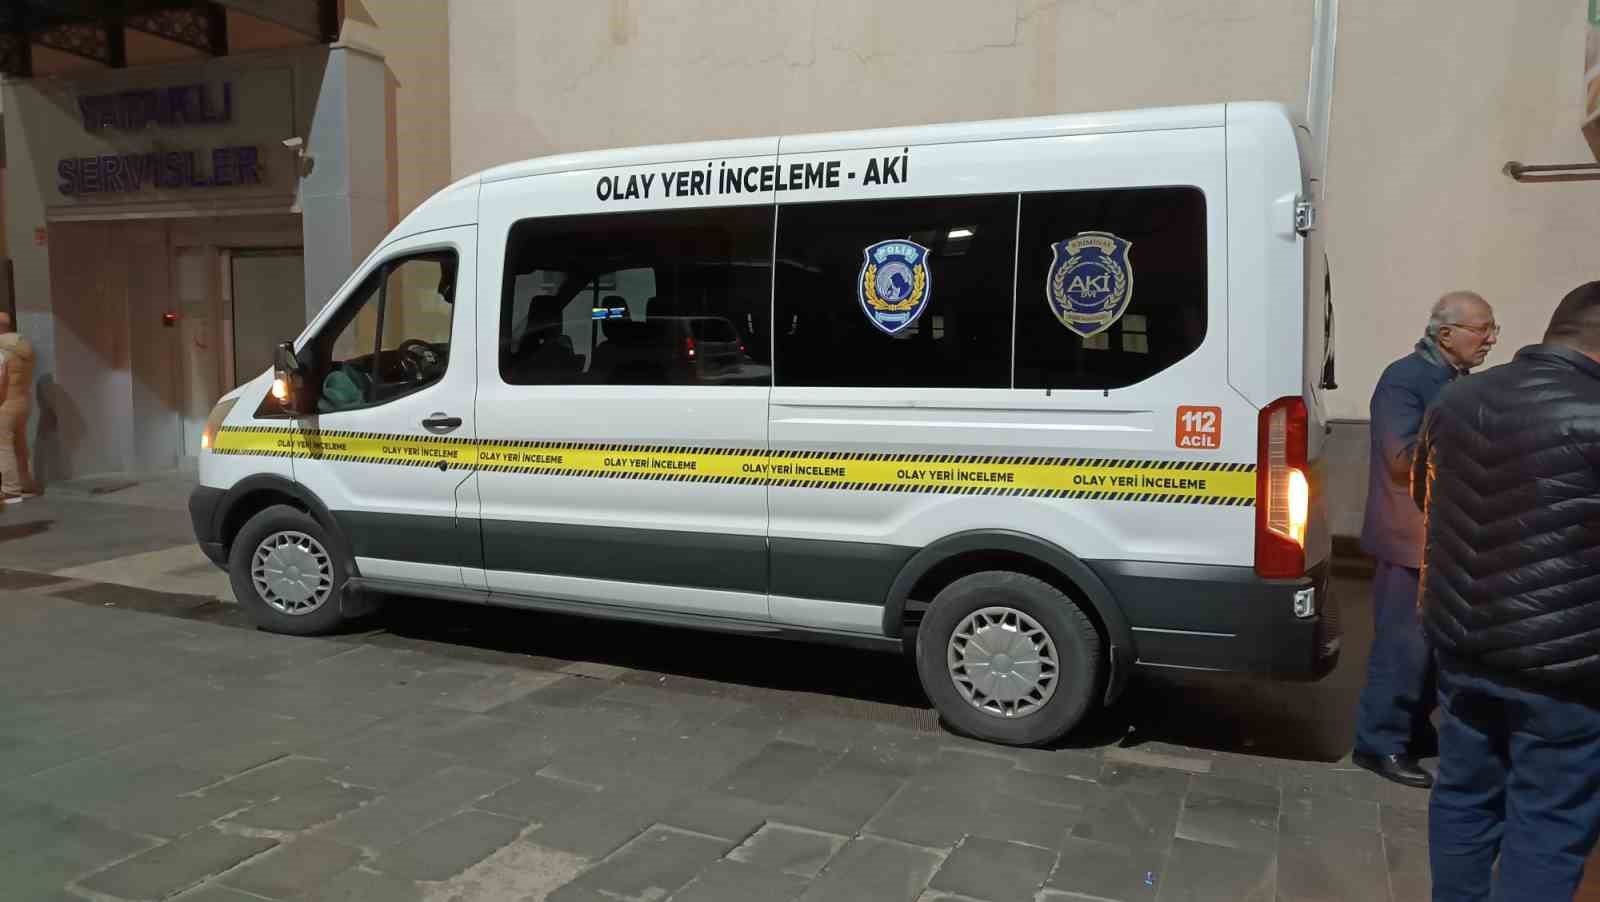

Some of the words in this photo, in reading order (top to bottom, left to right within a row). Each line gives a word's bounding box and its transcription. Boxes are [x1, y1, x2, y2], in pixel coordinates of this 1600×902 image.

[596, 173, 655, 201] OLAY
[661, 162, 712, 197] YERİ
[718, 161, 841, 194] İNCELEME
[862, 147, 909, 186] AKİ
[1067, 273, 1111, 292] AKİ
[1181, 411, 1215, 433] 112
[277, 439, 294, 449] OLAY
[1180, 435, 1215, 447] ACİL
[382, 446, 401, 455] OLAY
[421, 446, 459, 459] İNCELEME
[479, 452, 501, 461] OLAY
[503, 452, 520, 462] YERİ
[522, 452, 563, 464] İNCELEME
[603, 457, 627, 467] OLAY
[630, 457, 649, 468] YERİ
[651, 457, 697, 470] İNCELEME
[742, 464, 768, 473] OLAY
[770, 463, 793, 475] YERİ
[795, 463, 845, 477] İNCELEME
[896, 470, 925, 480] OLAY
[928, 470, 954, 482] YERİ
[957, 470, 1014, 483] İNCELEME
[1073, 475, 1106, 486] OLAY
[1109, 474, 1138, 488] YERİ
[1141, 475, 1206, 490] İNCELEME
